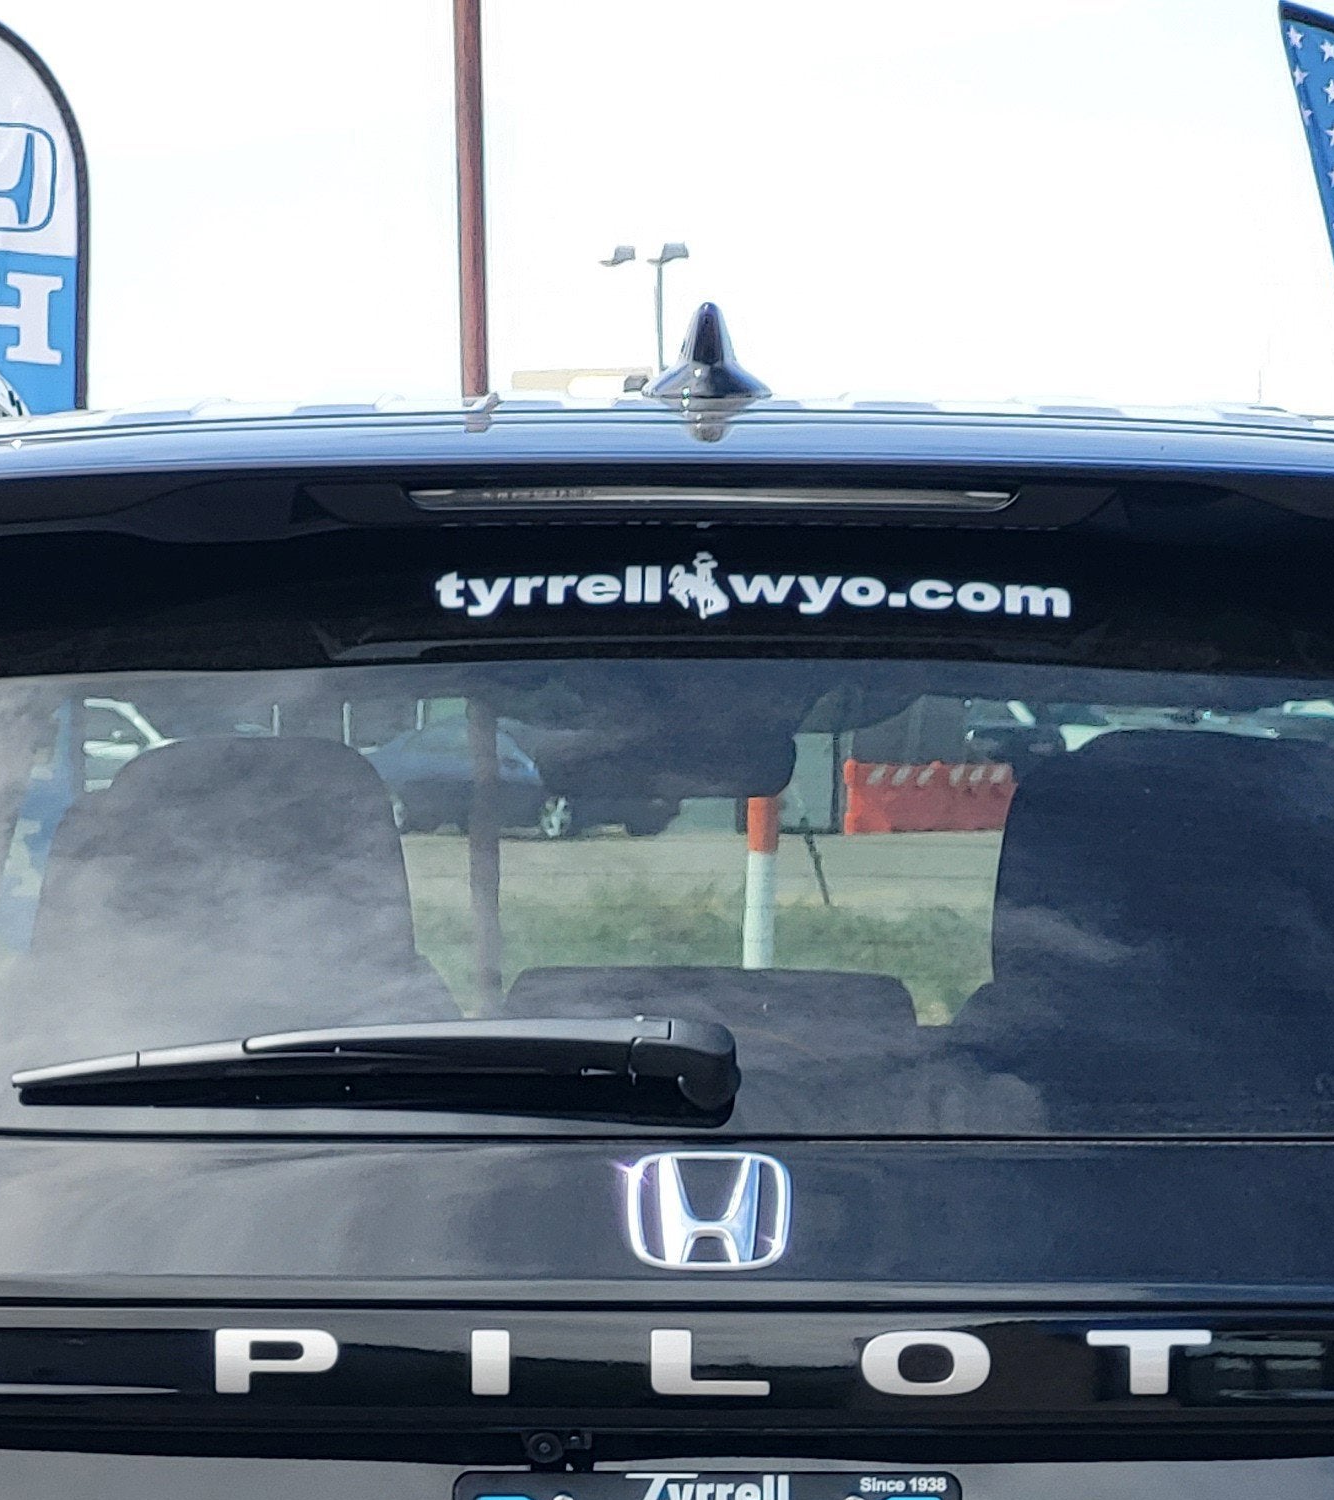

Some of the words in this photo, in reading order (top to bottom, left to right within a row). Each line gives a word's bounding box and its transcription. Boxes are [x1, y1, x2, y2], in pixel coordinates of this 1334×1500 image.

[214, 1328, 1213, 1396] PILOT
[859, 1476, 905, 1492] Since
[909, 1476, 948, 1492] 1938
